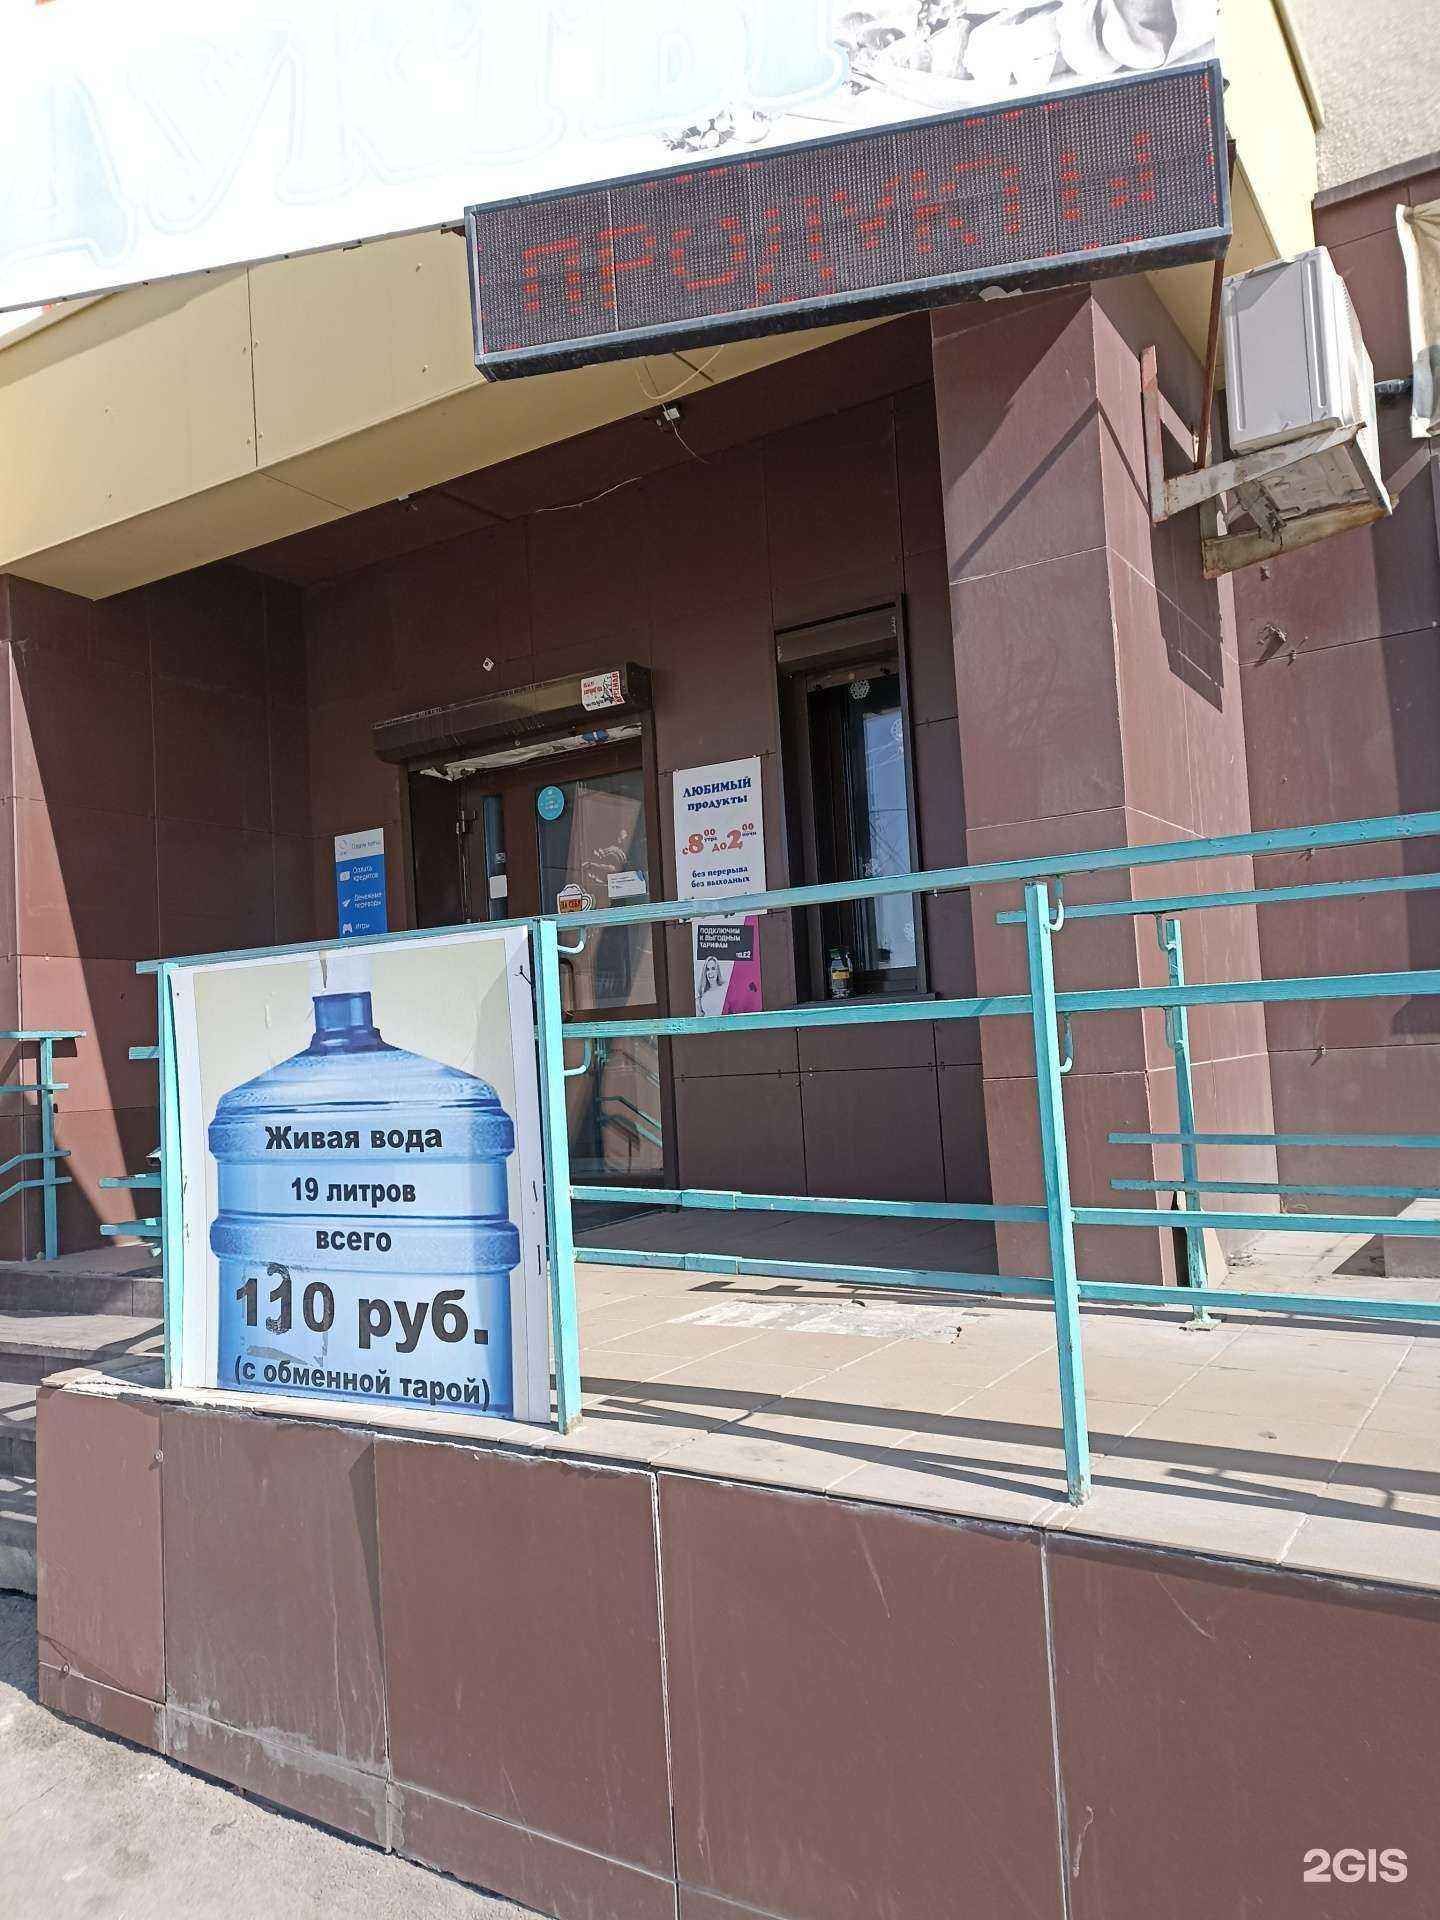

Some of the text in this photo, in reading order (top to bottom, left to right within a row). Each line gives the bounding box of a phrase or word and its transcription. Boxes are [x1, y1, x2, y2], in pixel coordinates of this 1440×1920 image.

[683, 776, 752, 798] ЛЮБИМЫЙ
[687, 795, 748, 812] продукты
[712, 842, 728, 852] до
[692, 866, 748, 878] без перерыва
[691, 877, 751, 888] без выходных
[700, 927, 741, 935] ПОДКЛЮЧИМ
[705, 934, 741, 942] ВЫГОДНЫМ
[264, 1125, 443, 1153] Живая вода
[291, 1177, 416, 1208] 19 литров
[316, 1230, 392, 1252] всего
[358, 1289, 489, 1354] руб.
[235, 1355, 490, 1412] (с обменной тарой)
